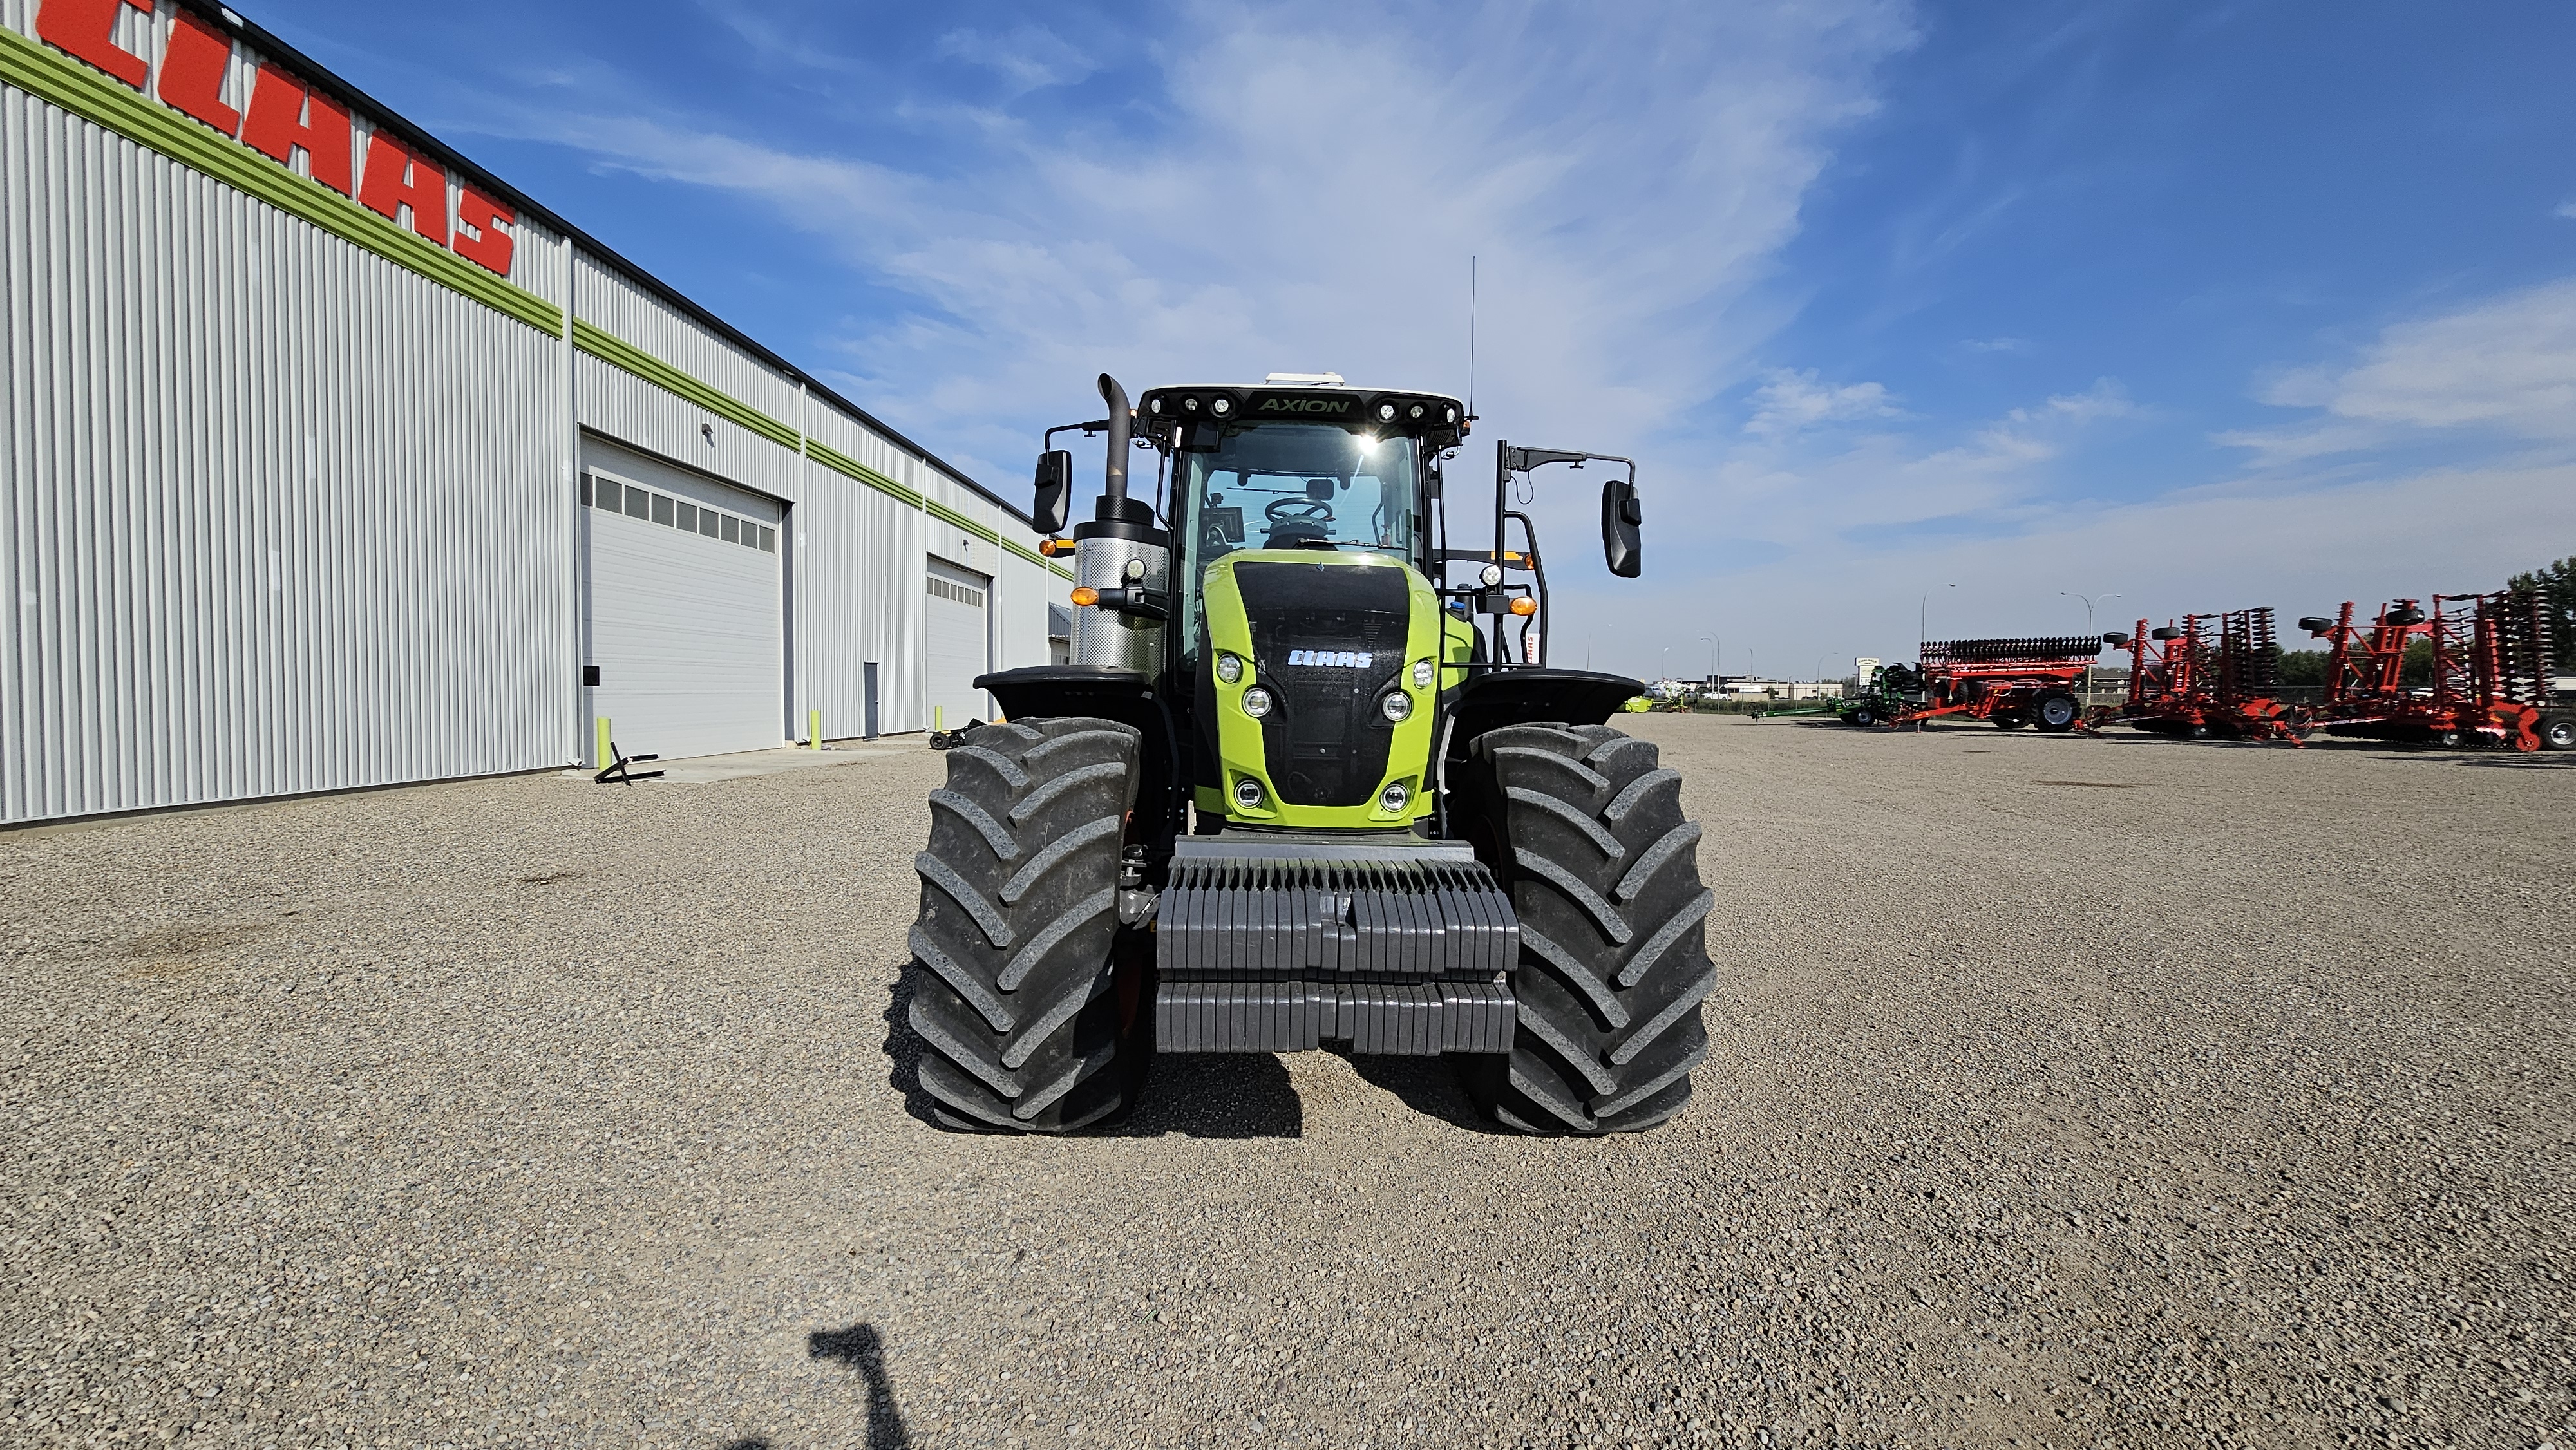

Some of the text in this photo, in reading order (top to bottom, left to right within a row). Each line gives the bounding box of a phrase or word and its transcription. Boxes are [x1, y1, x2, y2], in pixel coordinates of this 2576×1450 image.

[35, 0, 515, 276] CLAAS
[1258, 399, 1350, 413] AXION
[1288, 650, 1373, 668] CLAAS
